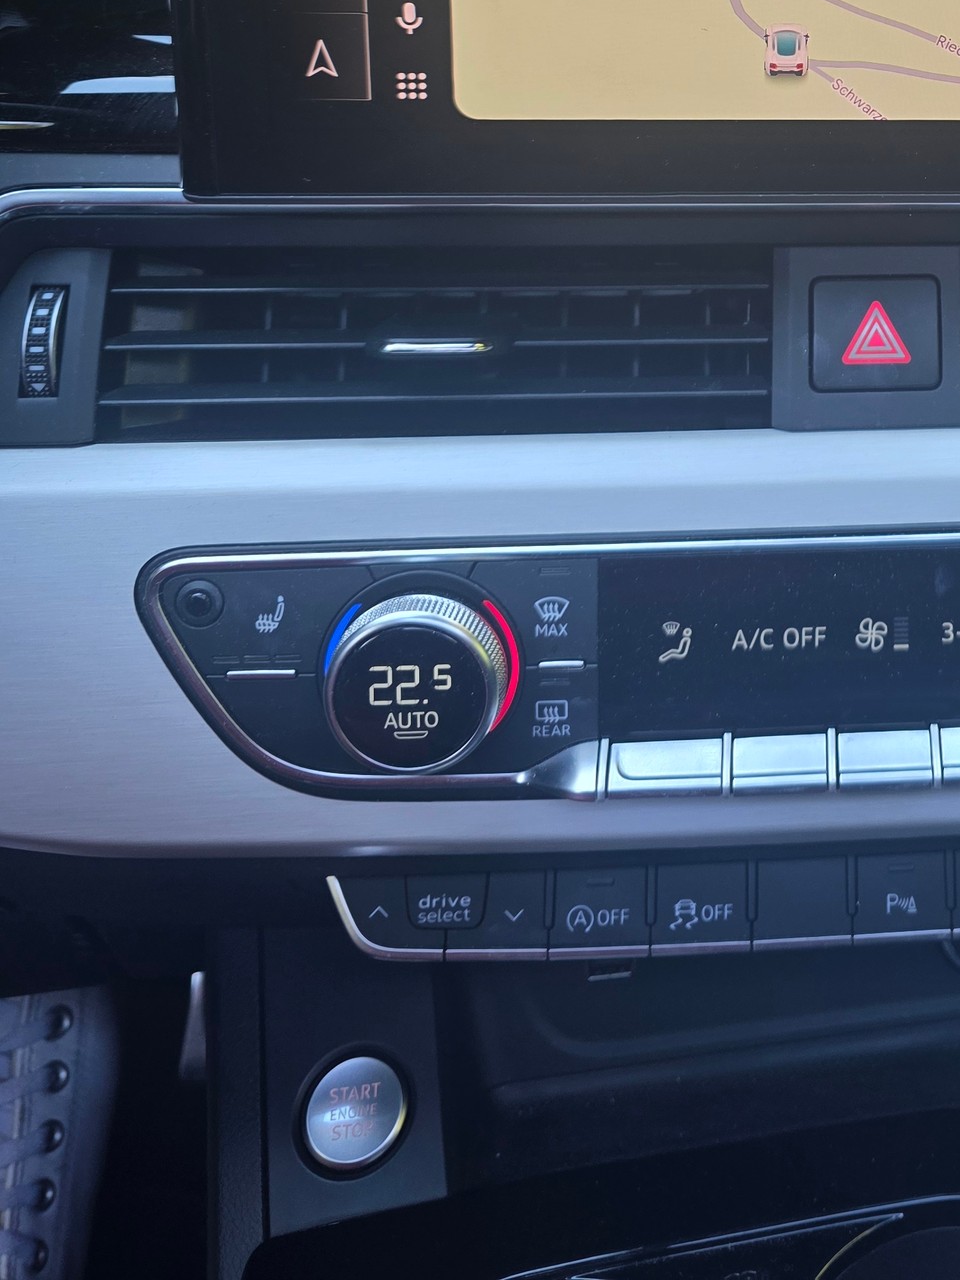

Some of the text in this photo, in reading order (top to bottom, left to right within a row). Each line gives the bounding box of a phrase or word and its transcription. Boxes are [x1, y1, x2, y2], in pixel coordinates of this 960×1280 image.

[535, 623, 568, 638] MAX
[731, 626, 827, 651] A/C OFF
[368, 663, 453, 707] 22.5
[384, 711, 439, 730] AUTO
[532, 724, 571, 738] REAR
[418, 893, 472, 910] drive
[417, 907, 471, 924] select
[597, 908, 630, 927] OFF
[701, 903, 734, 921] OFF
[329, 1081, 381, 1104] START
[330, 1103, 378, 1122] ENGINE
[331, 1120, 376, 1141] STOP
